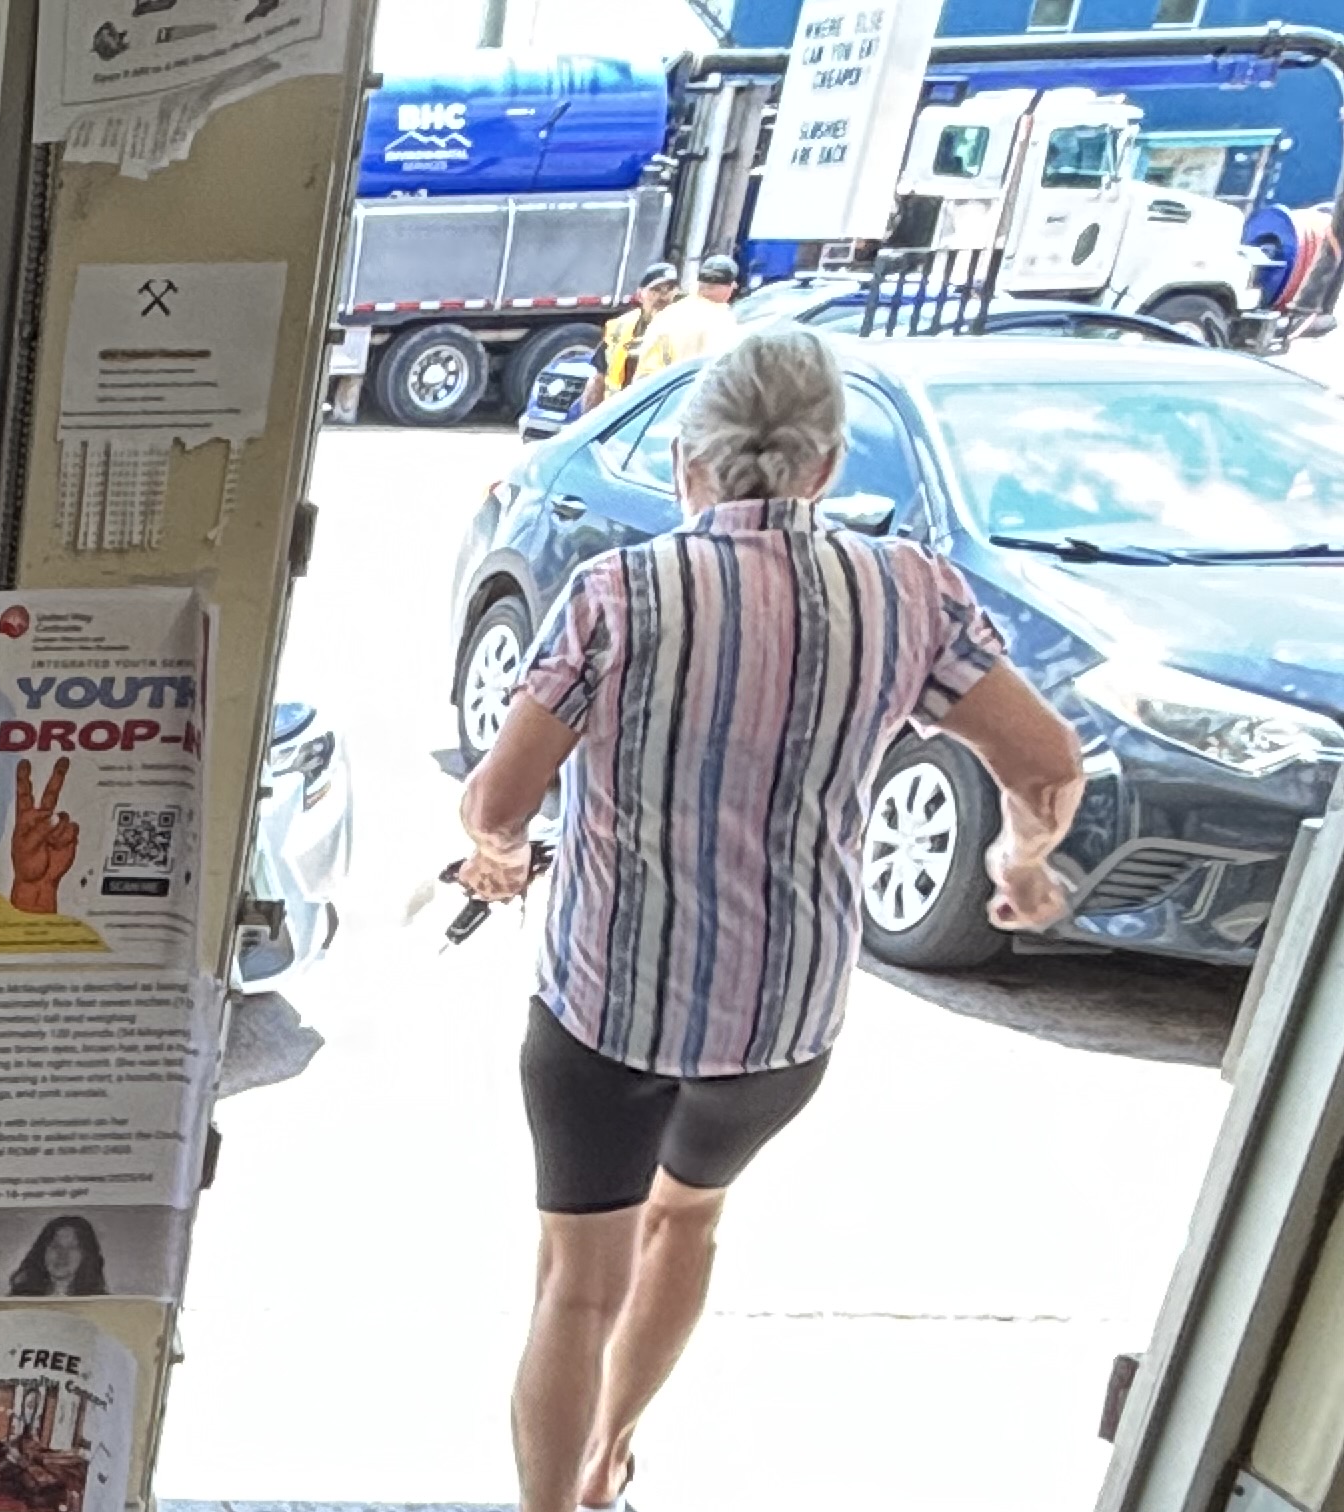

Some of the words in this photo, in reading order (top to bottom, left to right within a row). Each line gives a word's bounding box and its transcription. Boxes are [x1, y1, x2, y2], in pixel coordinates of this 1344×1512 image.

[398, 103, 467, 131] BHC
[31, 658, 110, 670] INTEGRATED
[17, 1347, 82, 1376] FREE
